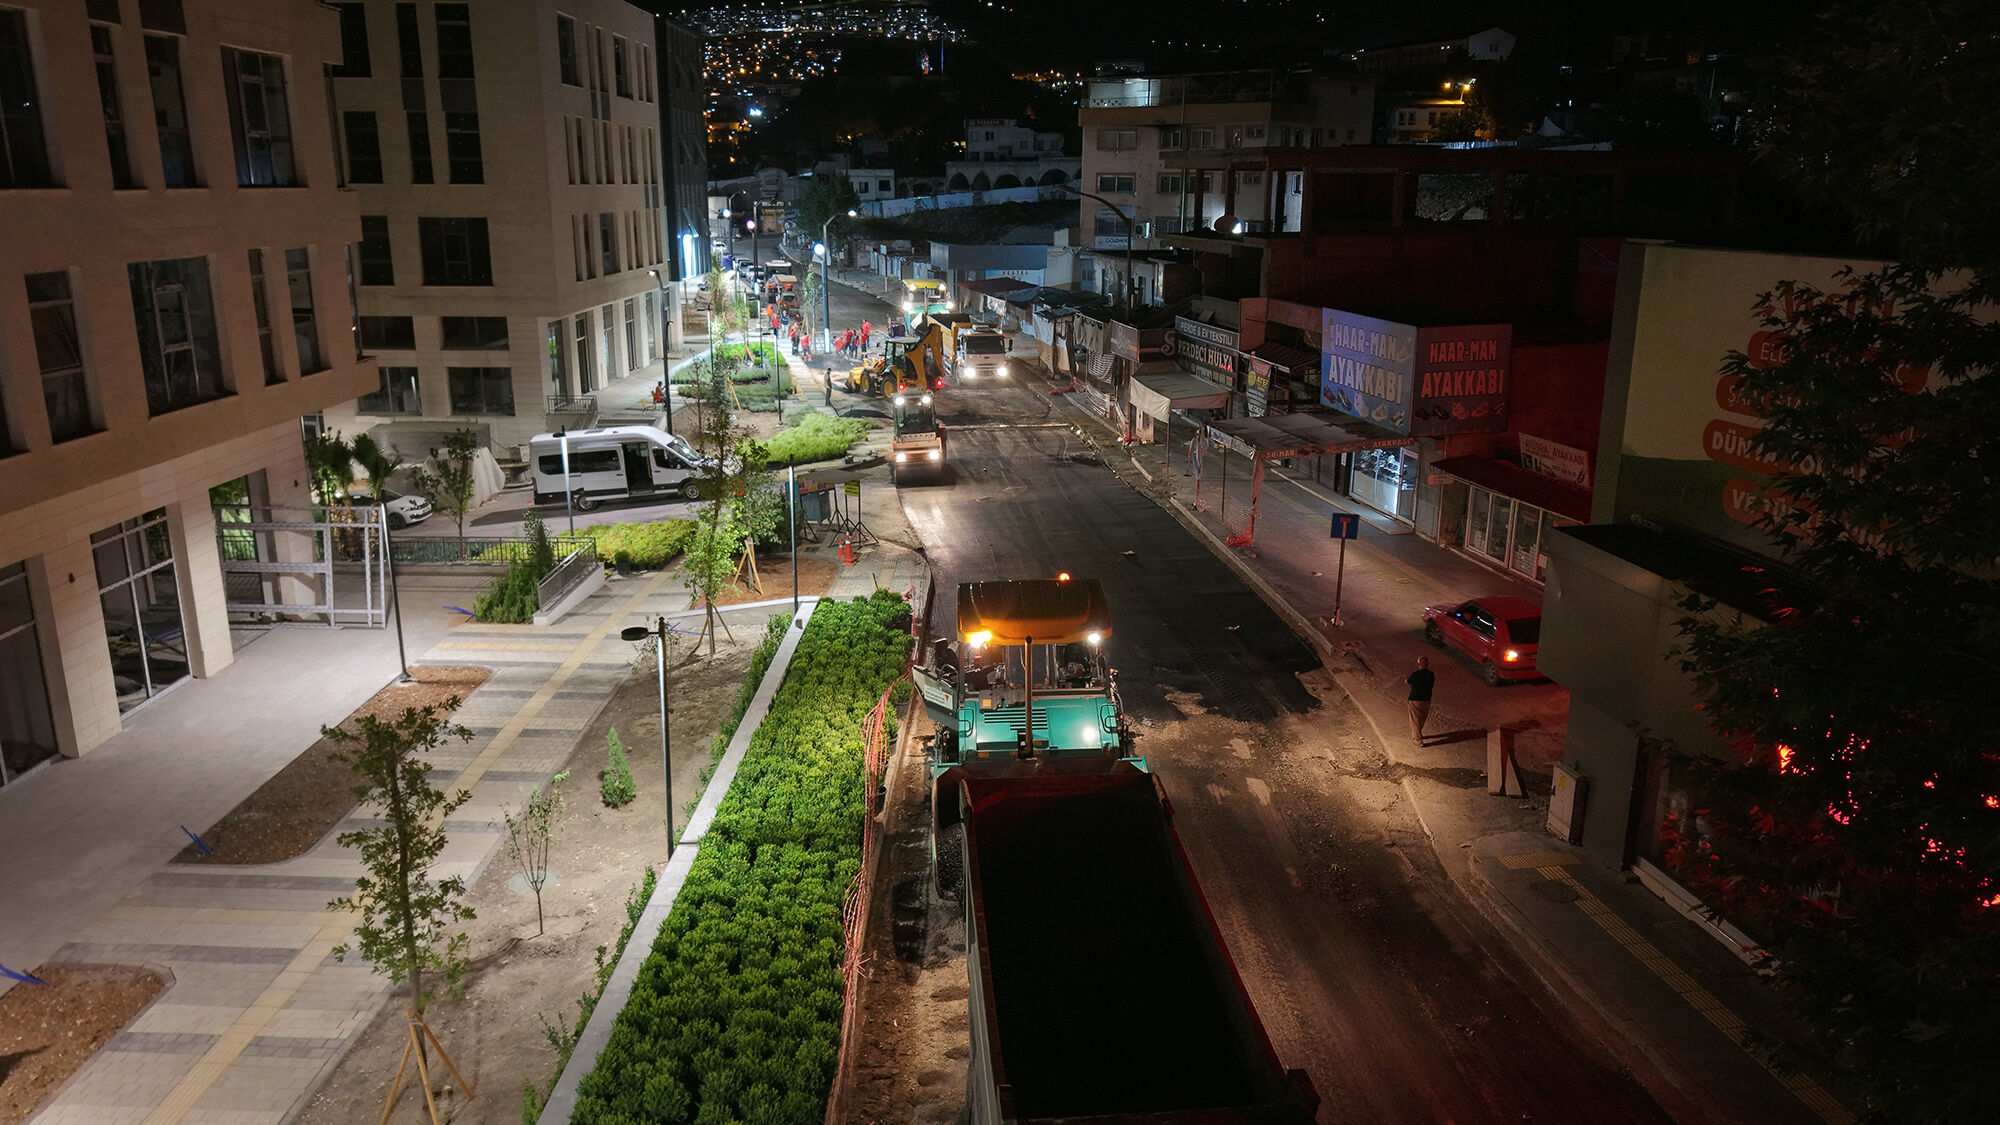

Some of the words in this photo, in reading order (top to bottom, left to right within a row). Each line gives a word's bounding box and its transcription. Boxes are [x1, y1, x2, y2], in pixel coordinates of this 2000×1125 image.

[1334, 322, 1398, 362] HAAR-MAN
[1429, 339, 1497, 364] HAAR-MAN
[1207, 347, 1234, 372] HÜLYA
[1327, 353, 1404, 405] AYAKKABI
[1420, 368, 1505, 399] AYAKKABI
